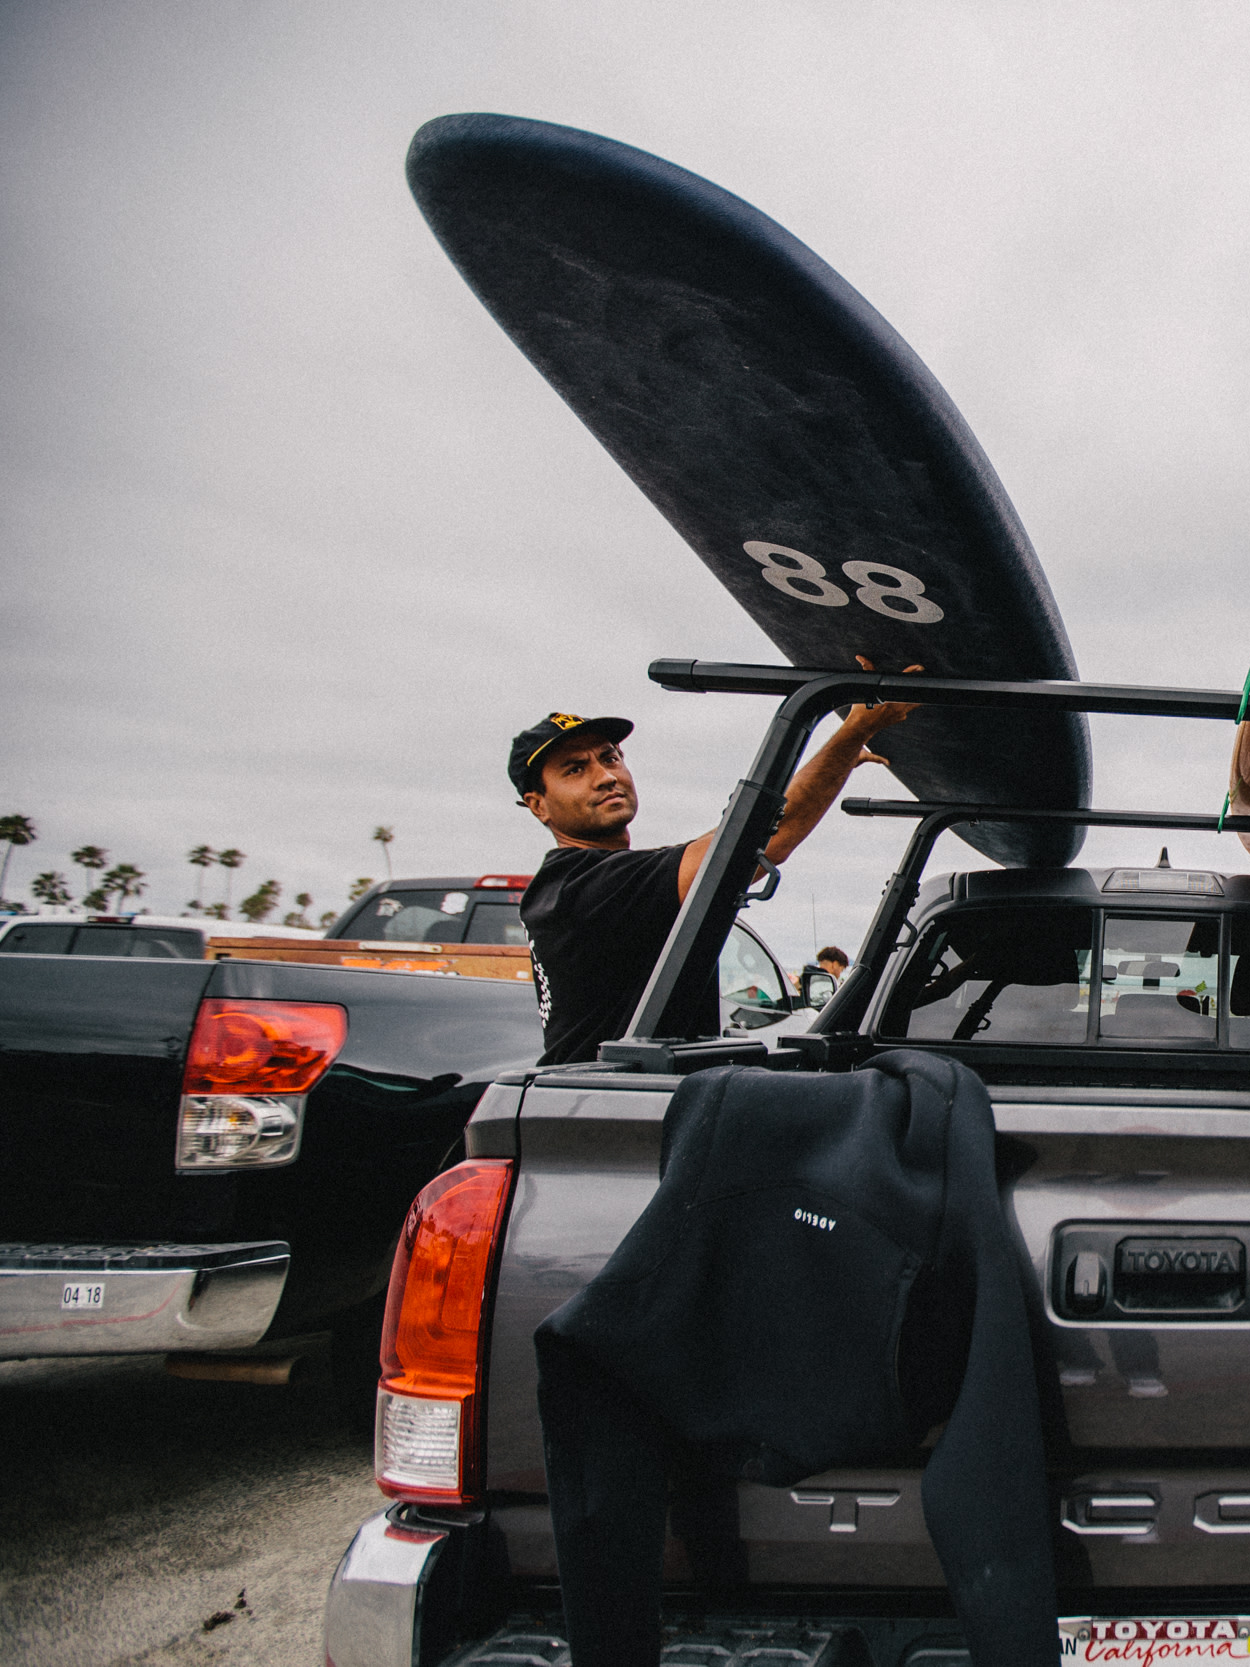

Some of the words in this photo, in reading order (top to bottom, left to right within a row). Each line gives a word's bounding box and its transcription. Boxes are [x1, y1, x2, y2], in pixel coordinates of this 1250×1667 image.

[743, 541, 944, 623] 88
[794, 1208, 836, 1231] ADELIO
[1127, 1249, 1238, 1272] TOYOTA
[64, 1286, 79, 1304] 04
[88, 1286, 101, 1304] 18
[1092, 1619, 1237, 1640] TOYOTA
[1084, 1638, 1250, 1667] California
